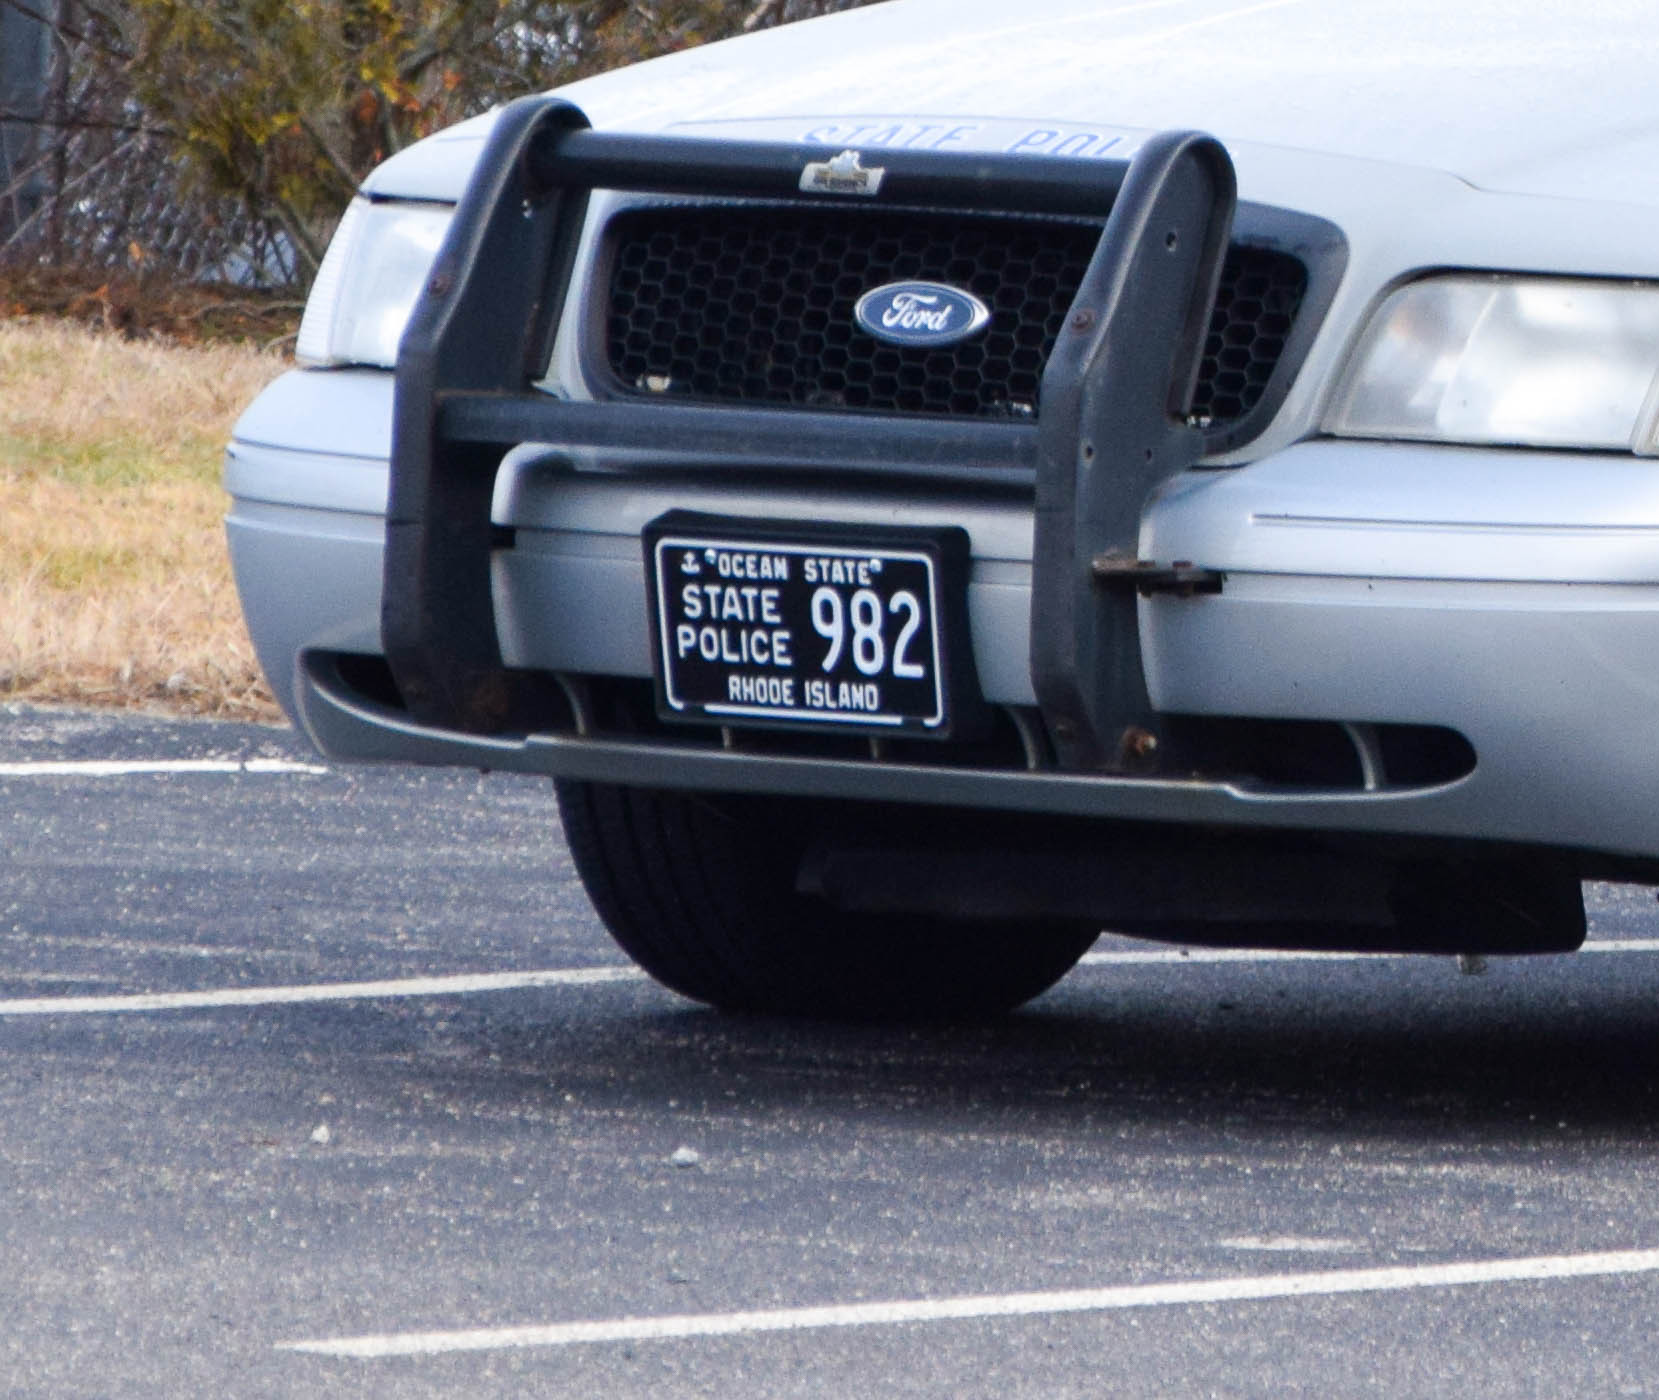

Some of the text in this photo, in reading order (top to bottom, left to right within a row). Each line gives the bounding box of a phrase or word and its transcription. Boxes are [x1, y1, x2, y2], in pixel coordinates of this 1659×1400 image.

[881, 290, 954, 333] Ford
[681, 583, 782, 624] STATE
[676, 625, 793, 668] POLICE
[810, 586, 925, 679] 982
[728, 674, 879, 712] RHODE ISLAND
